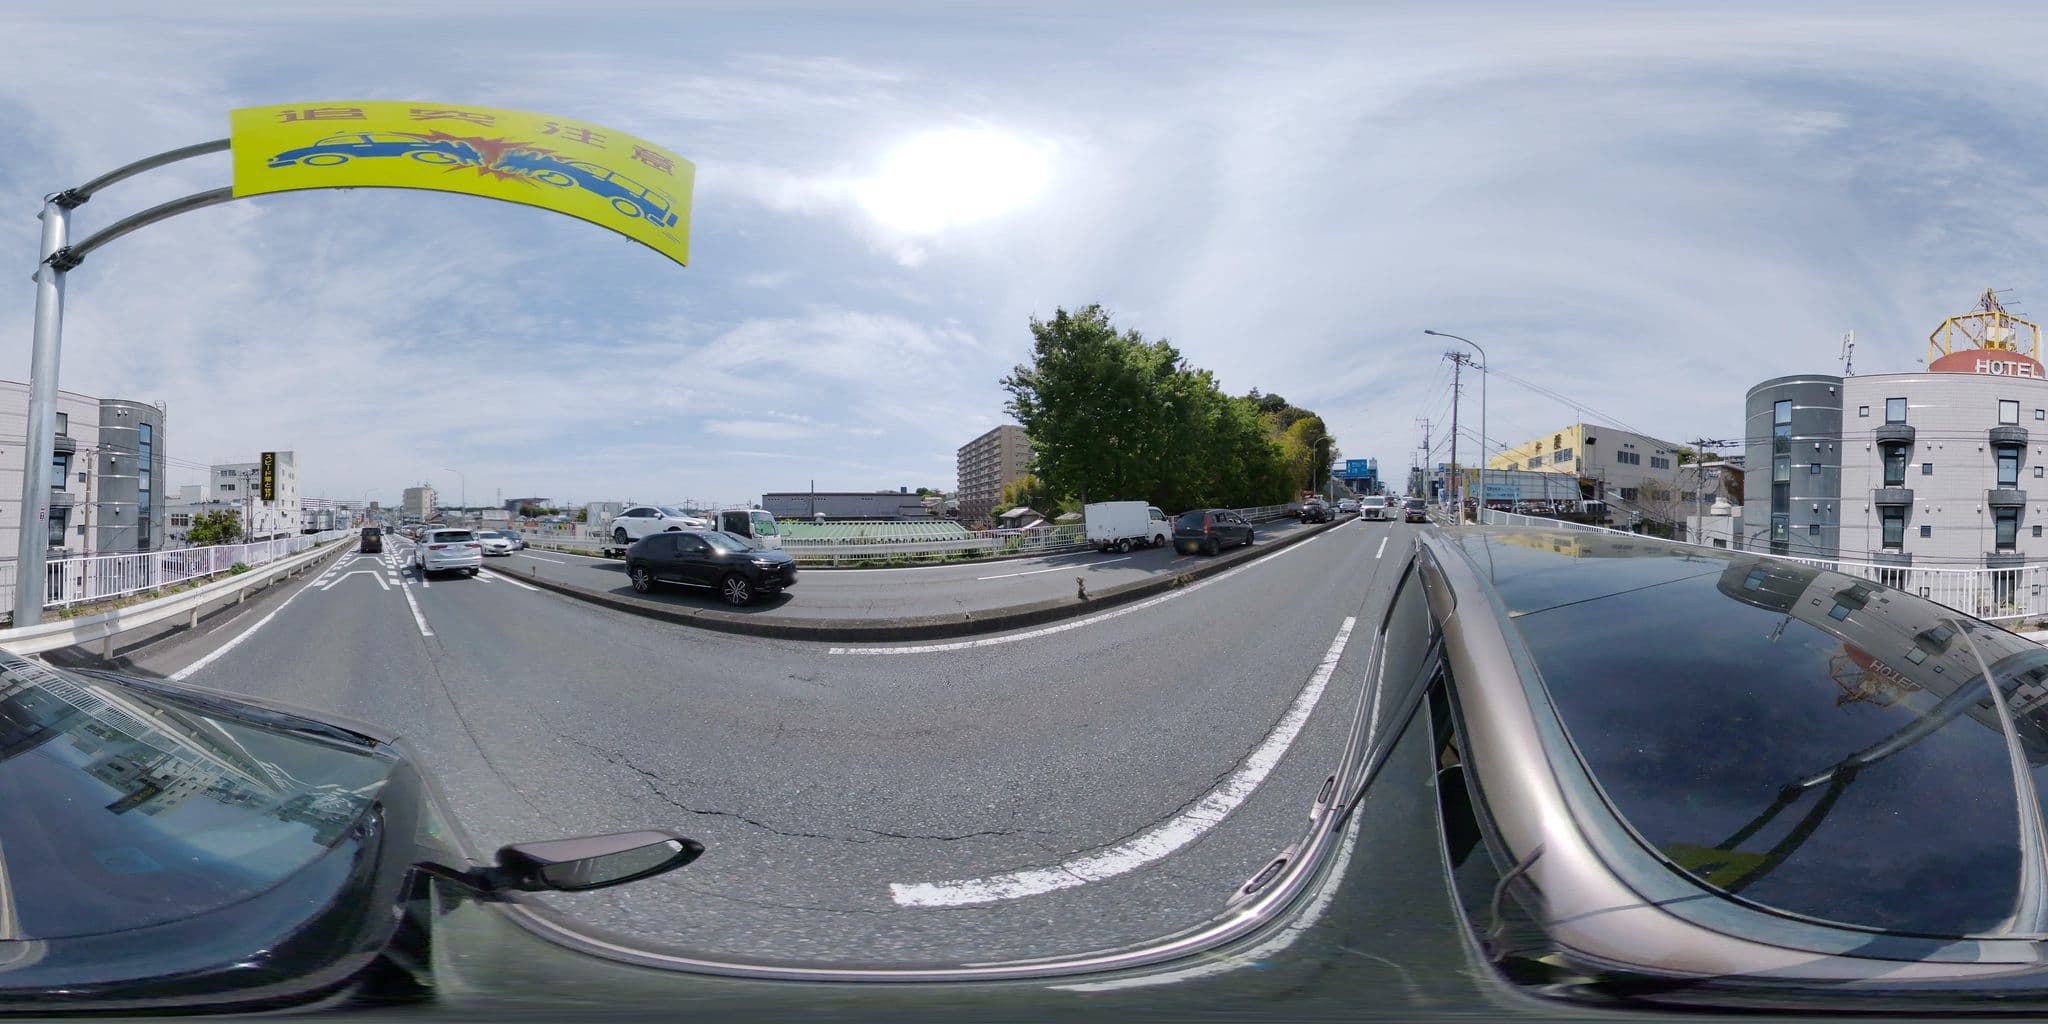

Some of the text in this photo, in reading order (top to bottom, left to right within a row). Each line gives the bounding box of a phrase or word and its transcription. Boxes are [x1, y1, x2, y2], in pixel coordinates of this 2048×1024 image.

[274, 107, 676, 176] 追突注意
[1976, 359, 2043, 378] HOTEL
